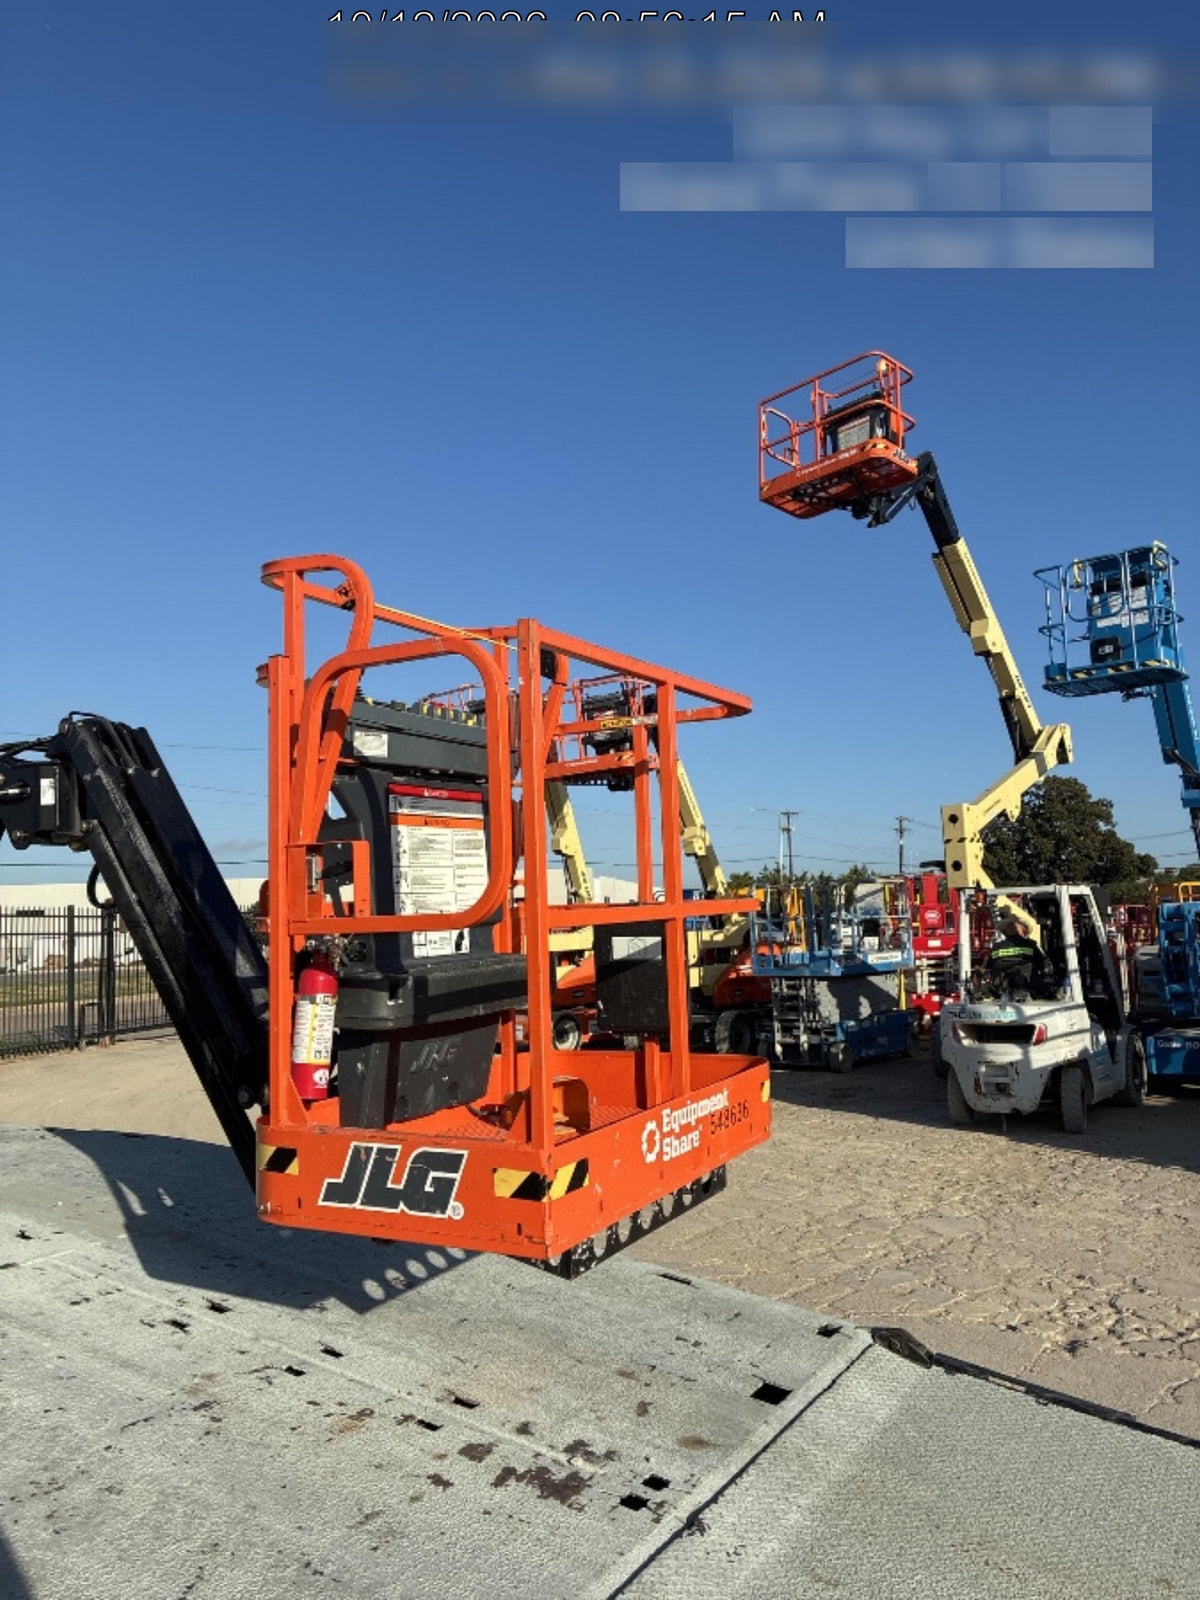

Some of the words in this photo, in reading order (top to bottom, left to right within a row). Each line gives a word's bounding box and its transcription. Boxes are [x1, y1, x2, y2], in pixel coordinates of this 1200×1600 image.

[661, 1087, 728, 1133] Equipment
[662, 1129, 700, 1162] Share
[317, 1141, 469, 1218] JLG
